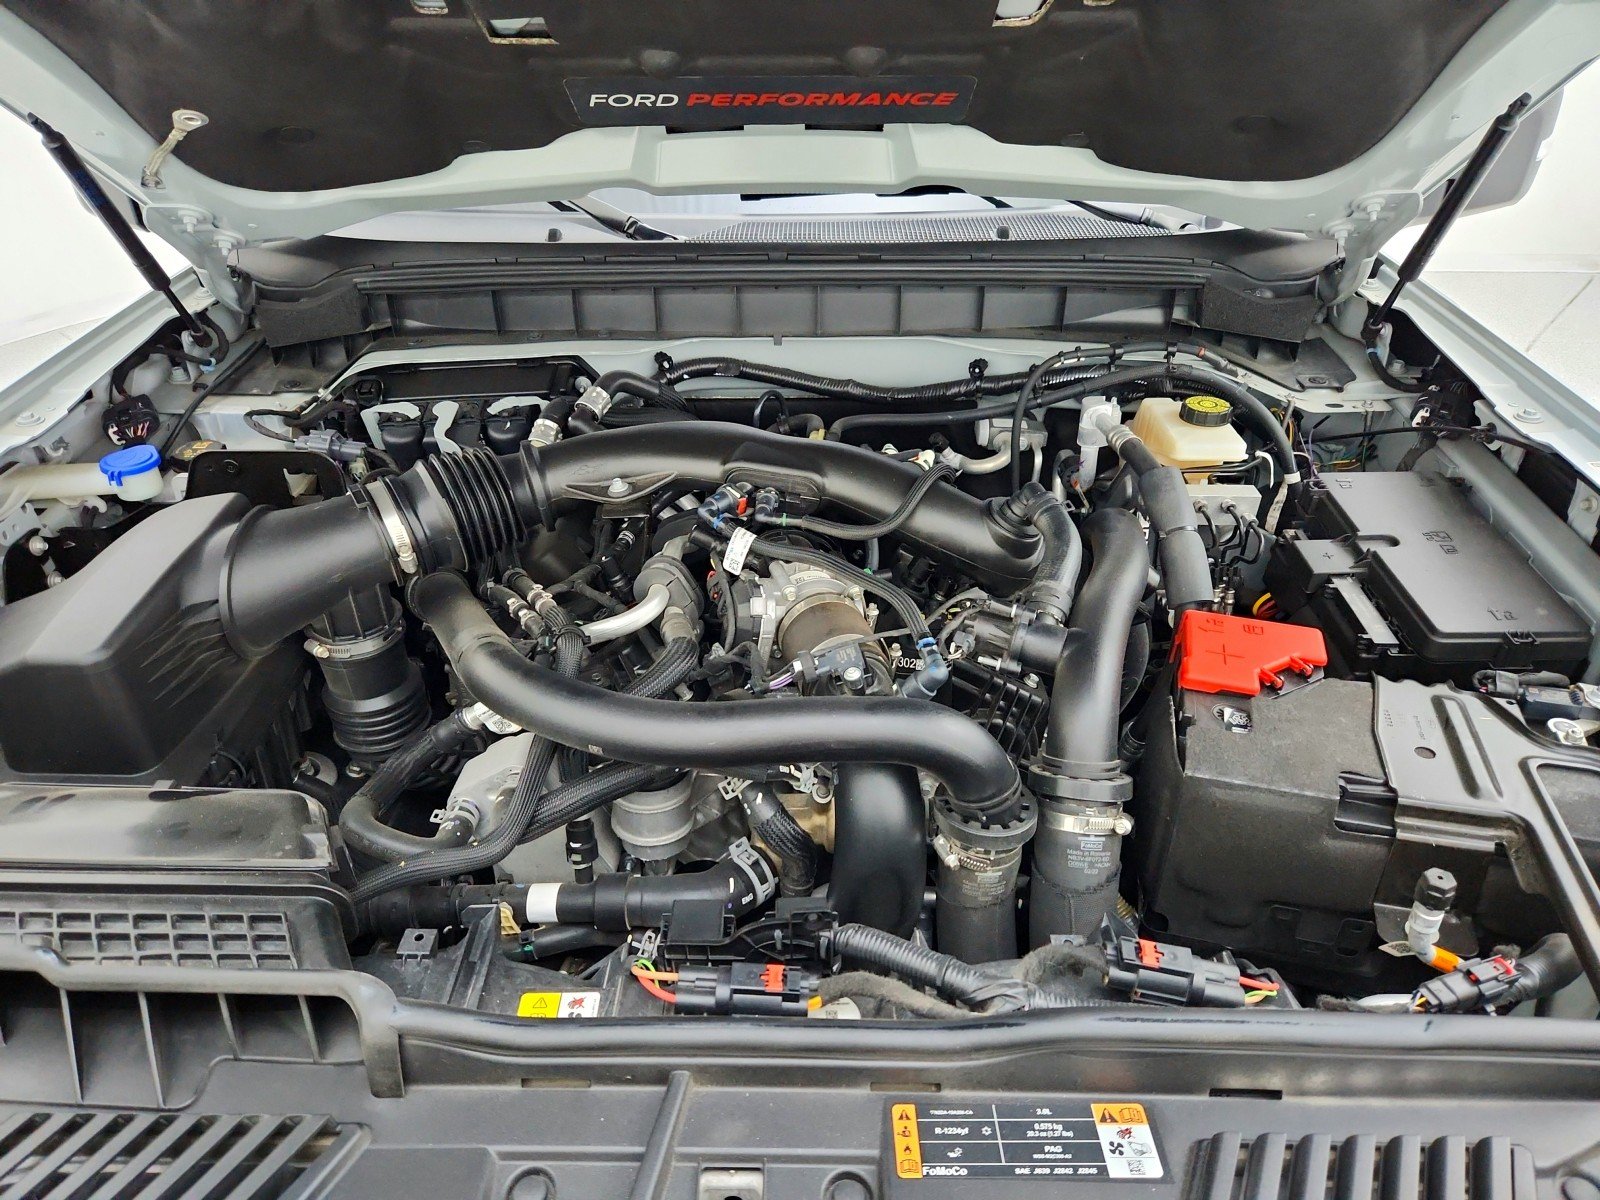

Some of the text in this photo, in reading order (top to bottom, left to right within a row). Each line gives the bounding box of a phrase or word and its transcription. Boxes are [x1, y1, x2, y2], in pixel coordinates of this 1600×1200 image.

[589, 92, 959, 107] FORD PERFORMANCE
[1053, 1123, 1063, 1131] kg
[934, 1127, 969, 1136] R-1234yf
[1044, 1145, 1063, 1153] PAG
[922, 1166, 968, 1176] FoMoCo
[1014, 1167, 1098, 1175] SAE J639 J2842 J2845
